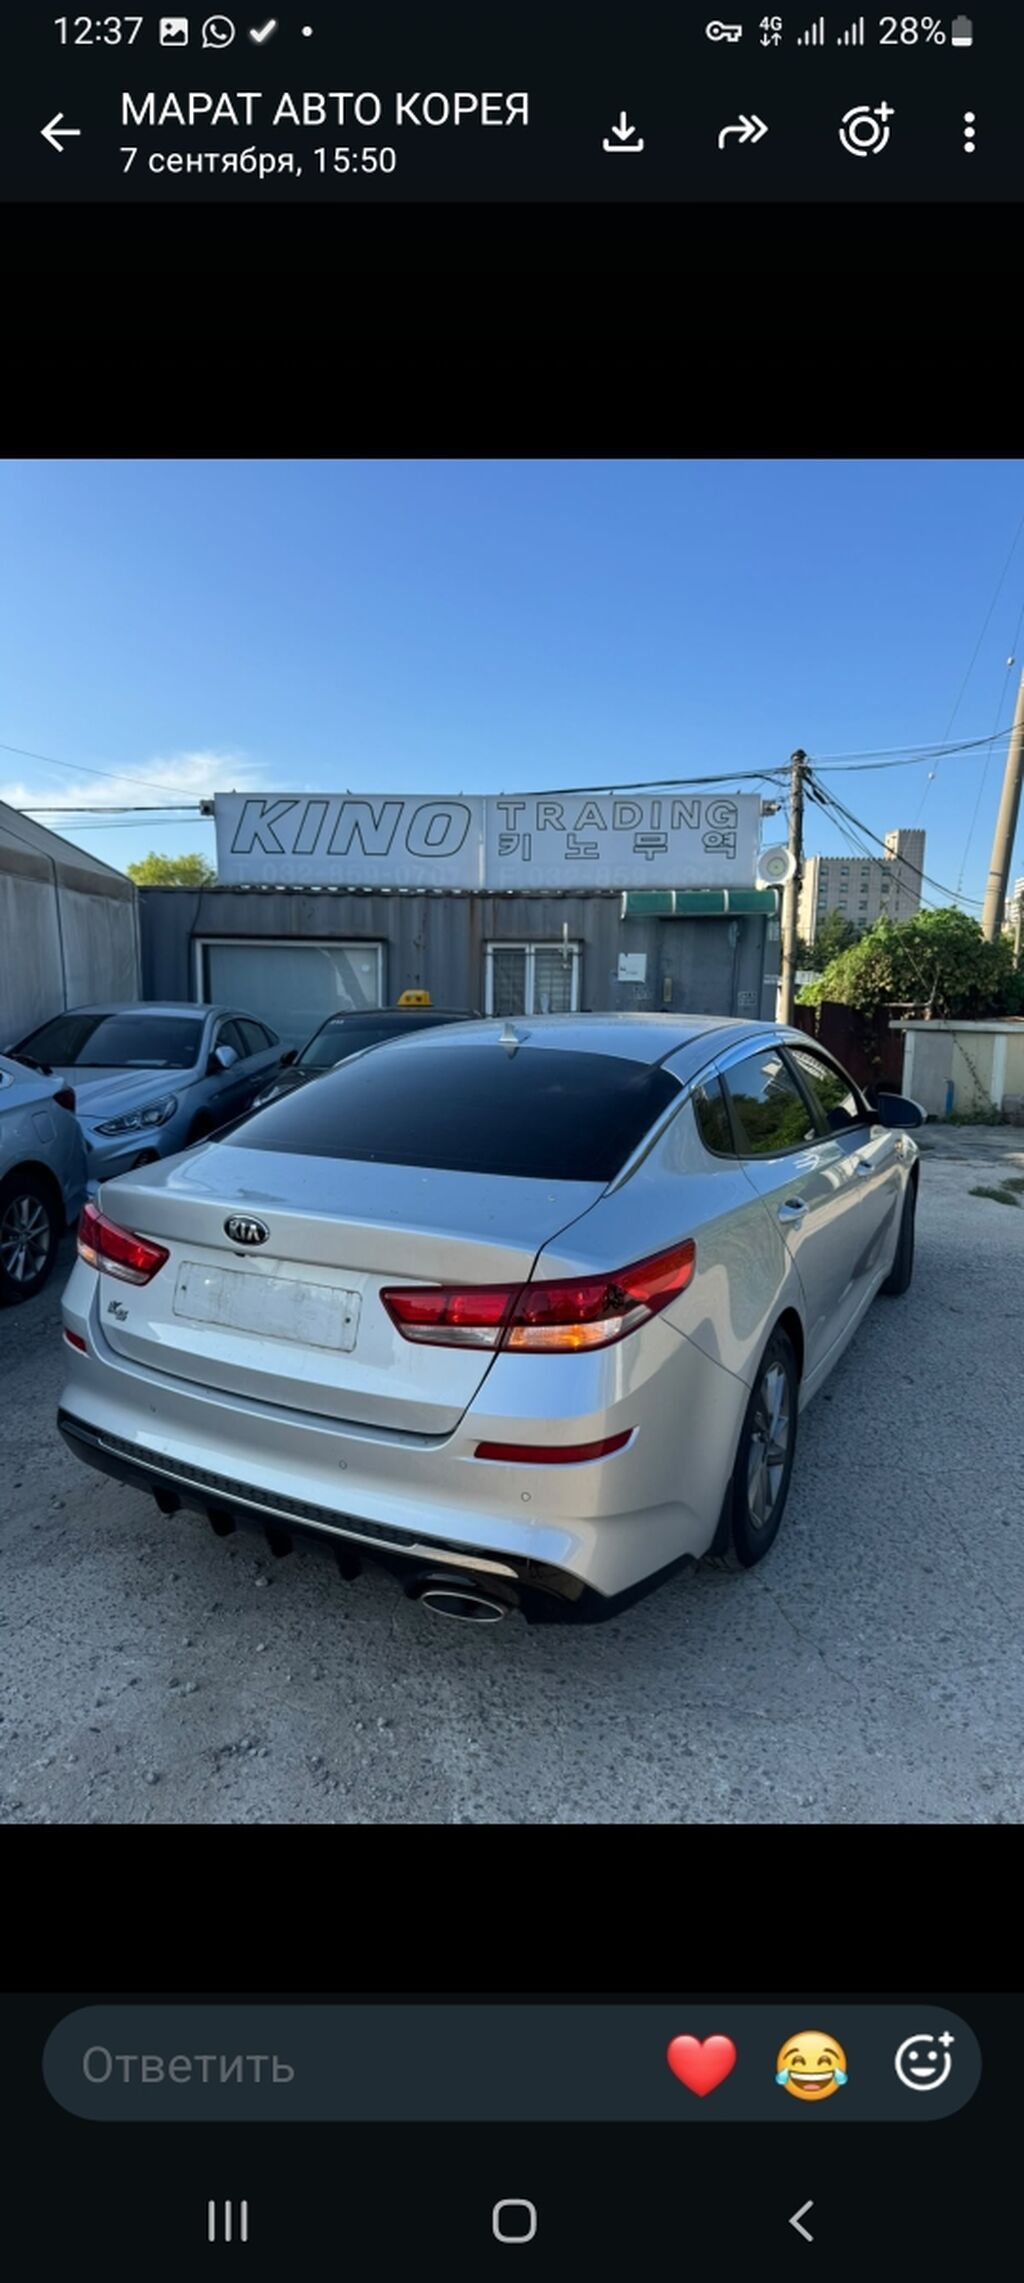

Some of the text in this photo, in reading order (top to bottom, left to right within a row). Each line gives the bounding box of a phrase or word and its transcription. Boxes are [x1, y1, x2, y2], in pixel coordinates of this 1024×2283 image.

[230, 799, 472, 858] KINO
[496, 800, 739, 831] TRADING
[229, 1220, 261, 1241] KIA
